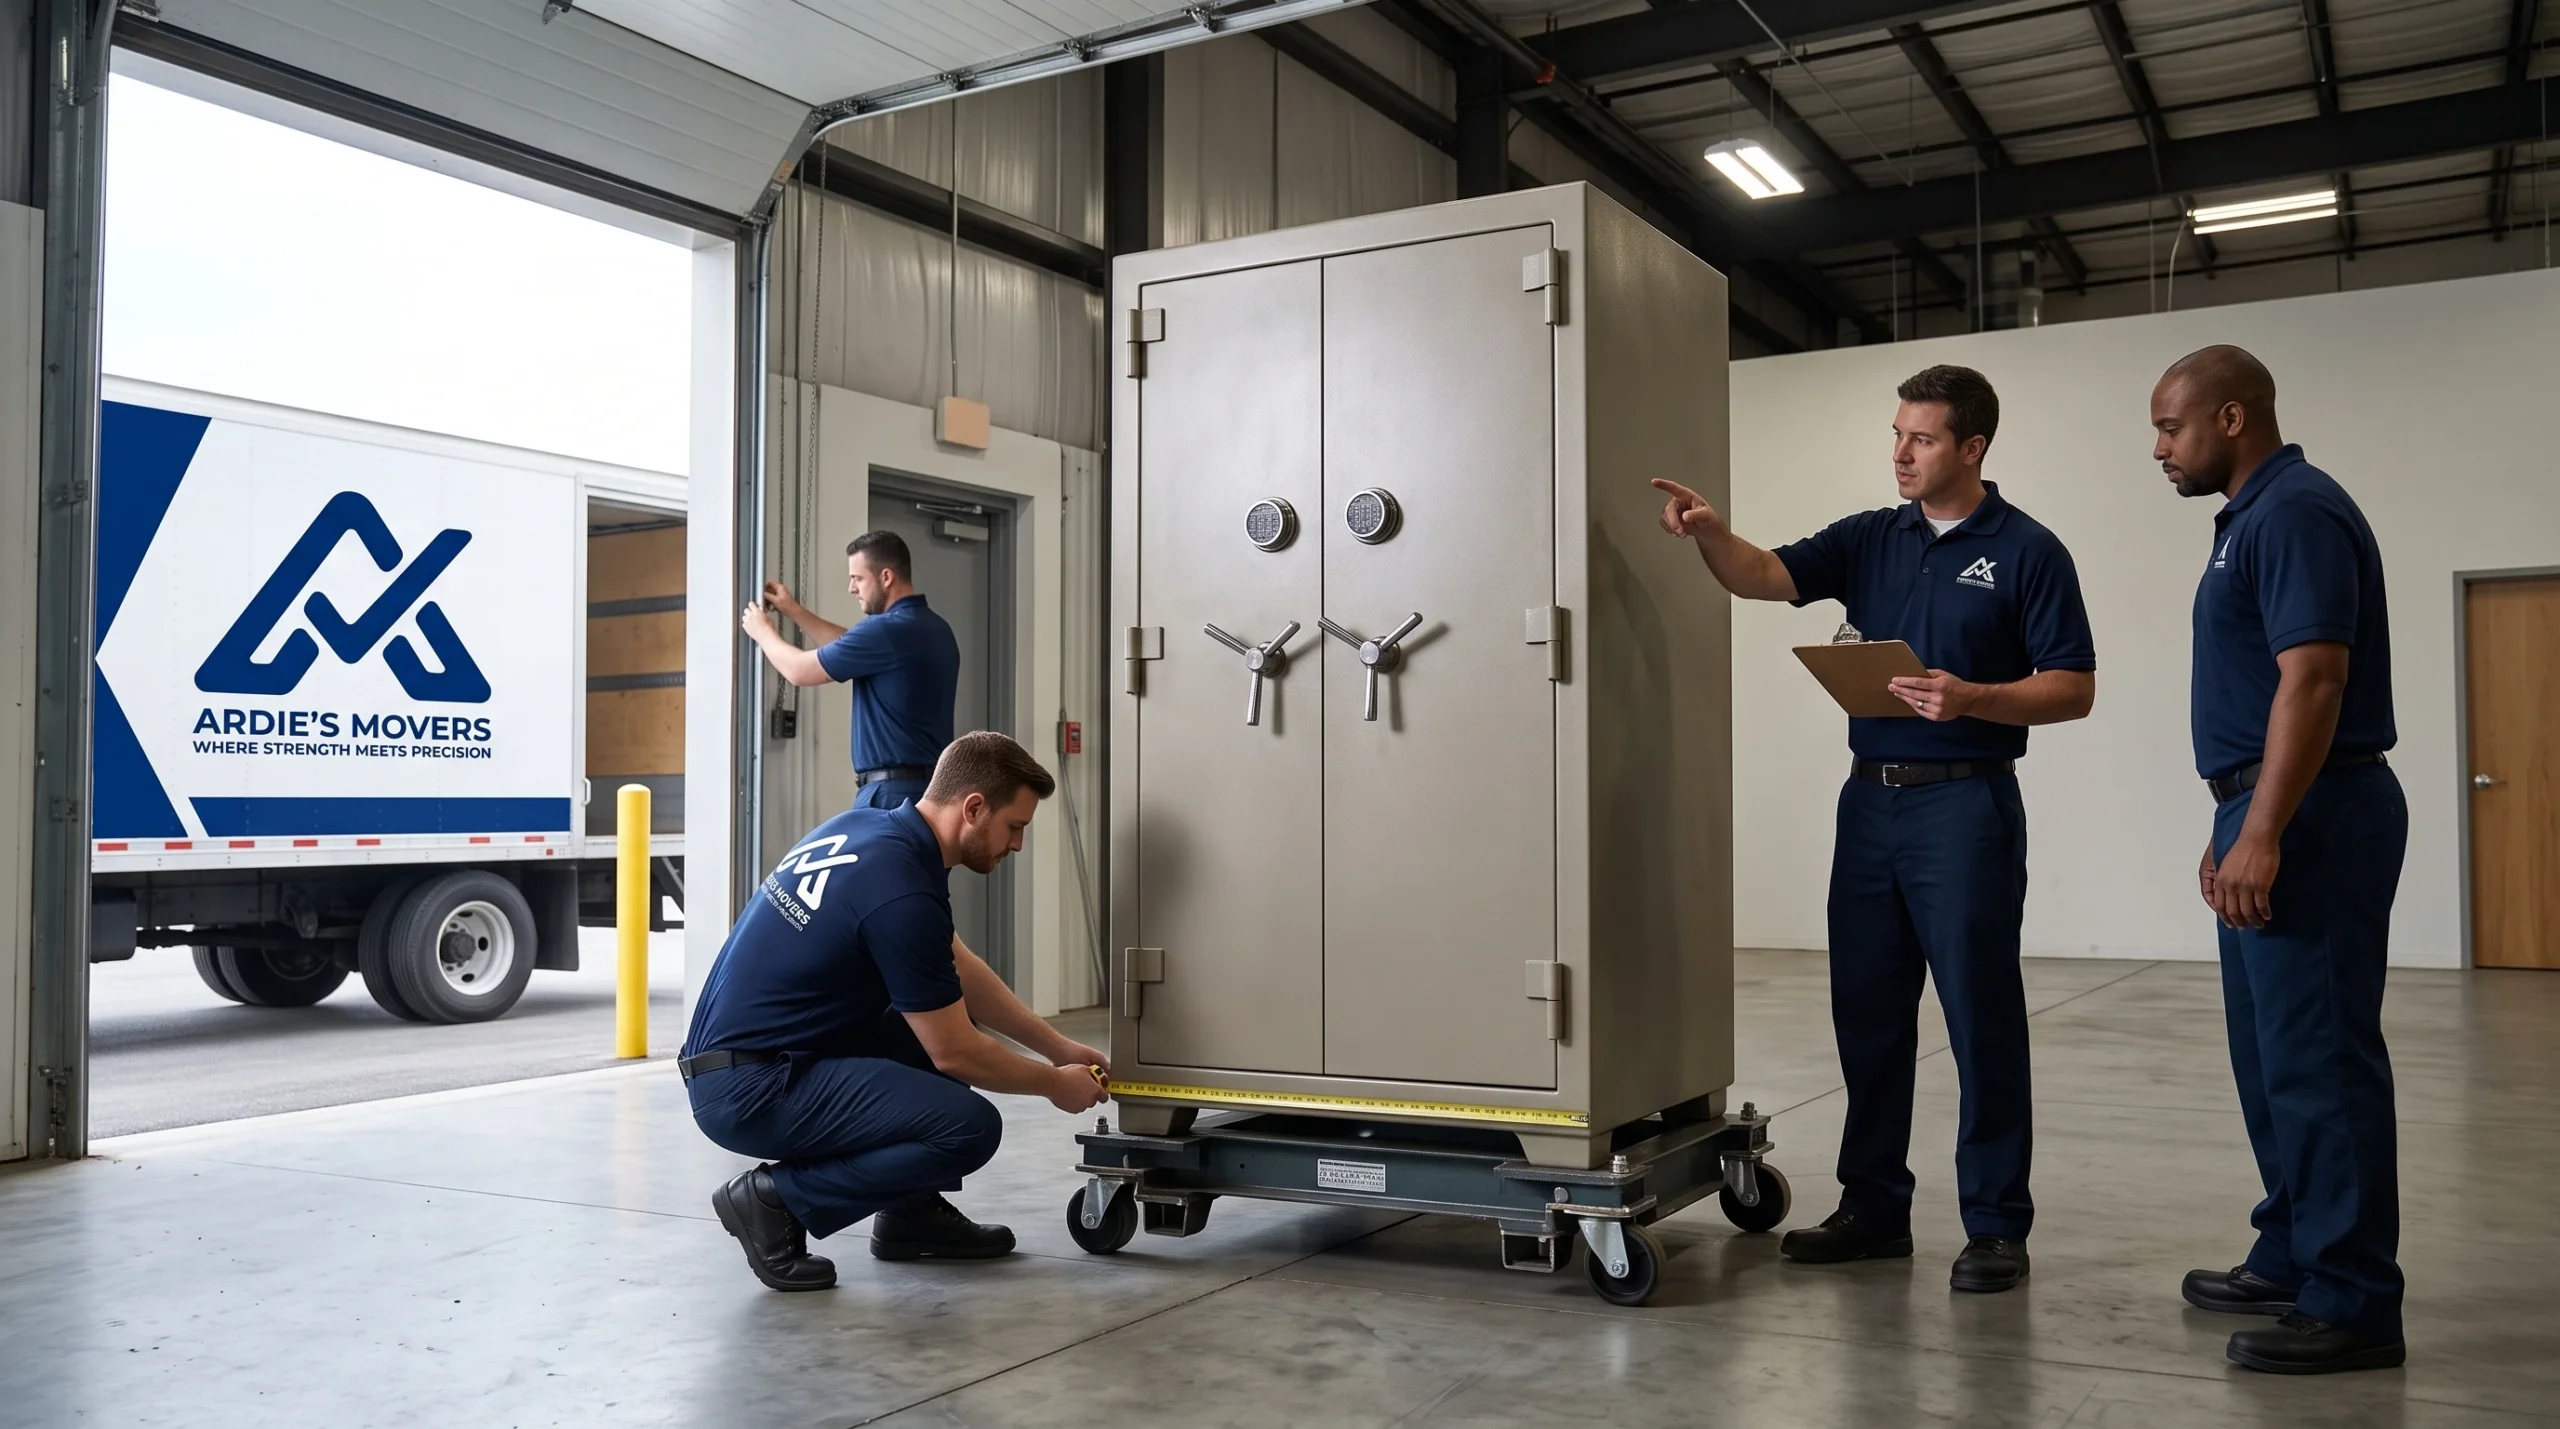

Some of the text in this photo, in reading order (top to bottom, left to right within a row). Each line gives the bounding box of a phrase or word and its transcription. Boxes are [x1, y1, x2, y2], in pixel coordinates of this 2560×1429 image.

[193, 708, 491, 742] ARDIE'S MOVERS
[193, 741, 492, 758] WHERE STRENGTH MEETS PRECISION
